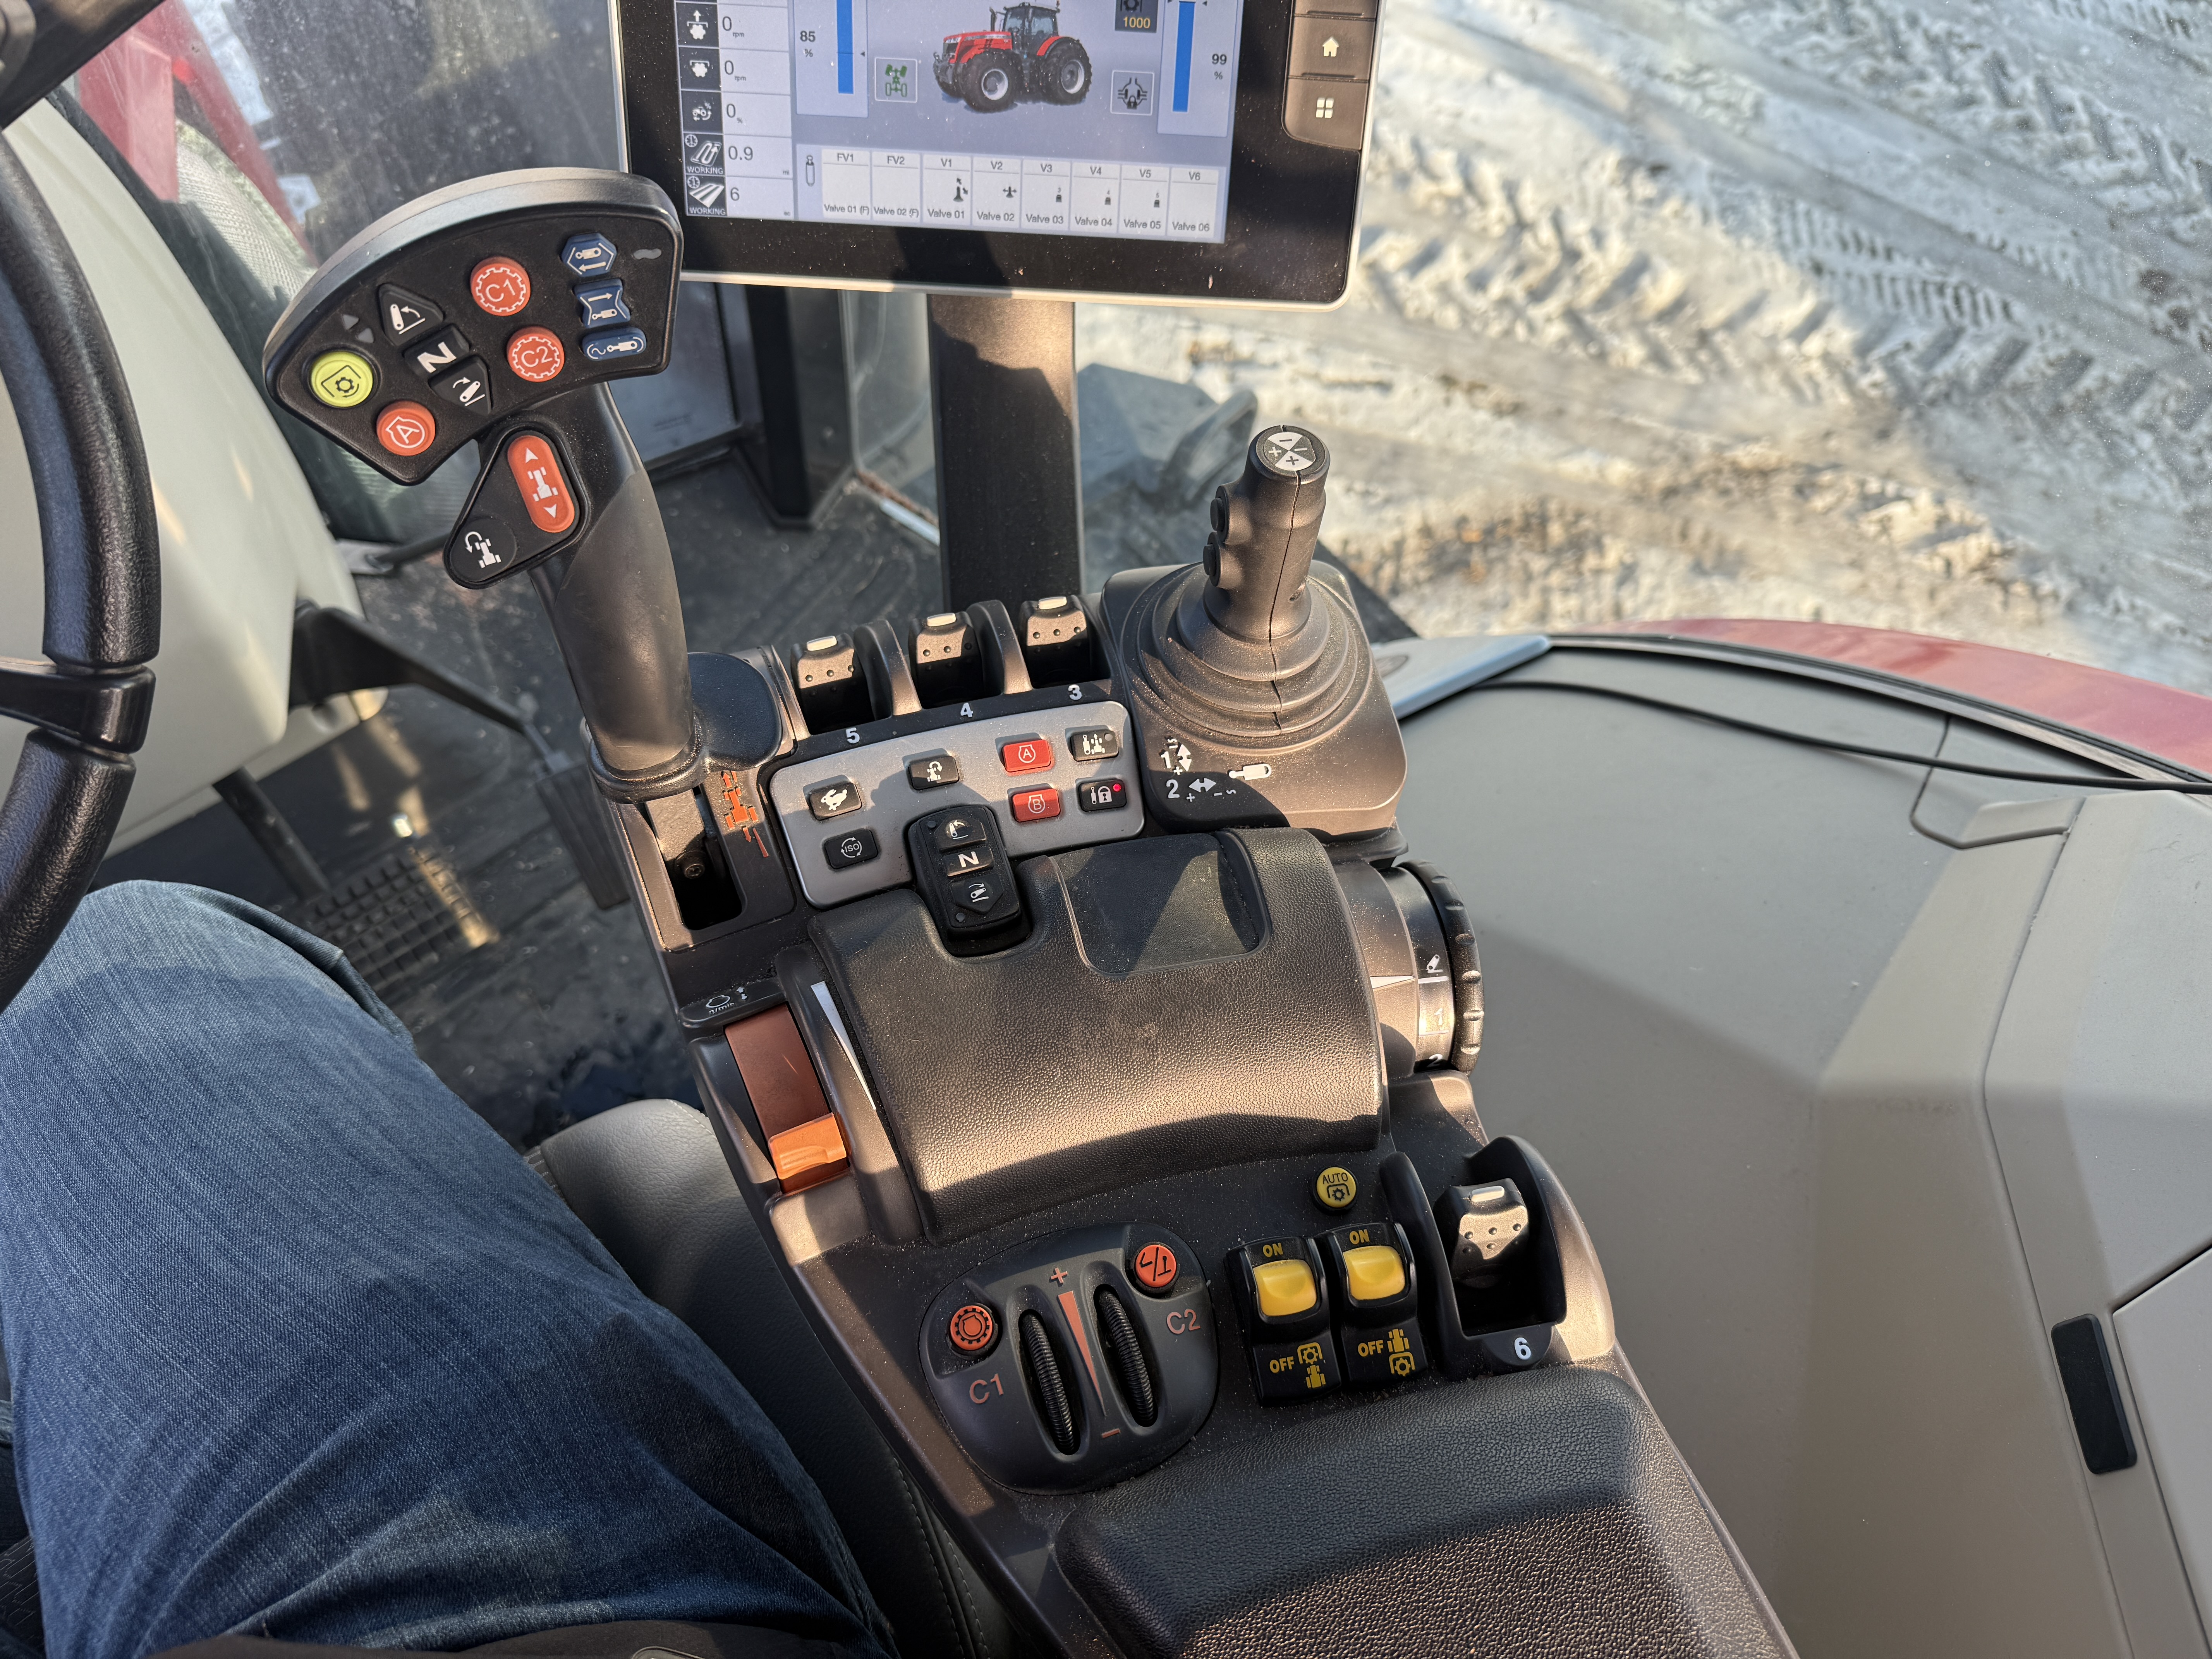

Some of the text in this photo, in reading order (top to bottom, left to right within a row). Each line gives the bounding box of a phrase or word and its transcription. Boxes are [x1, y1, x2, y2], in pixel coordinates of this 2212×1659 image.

[722, 16, 732, 31] 0
[1123, 16, 1151, 29] 1000
[800, 31, 816, 42] 85
[804, 49, 813, 57] %
[1212, 53, 1227, 65] 99
[725, 60, 734, 75] 0
[1214, 71, 1223, 80] %
[726, 104, 736, 117] 0
[728, 146, 753, 161] 0.9
[837, 153, 854, 162] FV1
[887, 156, 905, 165] FV2
[941, 159, 951, 167] V1
[991, 161, 1003, 170] V2
[1041, 163, 1053, 173] V3
[1090, 167, 1102, 175] V4
[1139, 169, 1151, 178] V5
[1188, 172, 1200, 181] V6
[730, 187, 740, 201] 6
[689, 207, 726, 215] WORKING
[824, 204, 845, 213] Valve
[860, 206, 869, 215] (F)
[874, 207, 895, 215] Valve
[909, 209, 919, 218] (F)
[928, 209, 964, 218] Valve 01
[977, 211, 1015, 222] Valve 02
[1026, 214, 1064, 224] Valve 03
[1075, 216, 1112, 227] Valve 04
[1124, 220, 1161, 229] Valve 05
[1172, 222, 1210, 232] Valve 06
[485, 279, 516, 302] C1
[417, 342, 457, 373] N
[521, 346, 553, 368] C2
[396, 425, 420, 443] A
[1068, 684, 1082, 701] 3
[960, 702, 973, 718] 4
[846, 727, 860, 744] 5
[1023, 748, 1032, 759] A
[1161, 751, 1171, 769] 1
[1166, 779, 1180, 799] 2
[1032, 799, 1042, 810] B
[845, 843, 859, 852] ISO
[958, 851, 979, 867] N
[1322, 1172, 1348, 1184] AUTO
[1349, 1228, 1370, 1244] ON
[1262, 1243, 1283, 1257] ON
[1167, 1309, 1200, 1334] C2
[1357, 1340, 1383, 1357] OFF
[1514, 1337, 1531, 1360] 6
[1269, 1356, 1294, 1373] OFF
[969, 1373, 1004, 1404] C1
